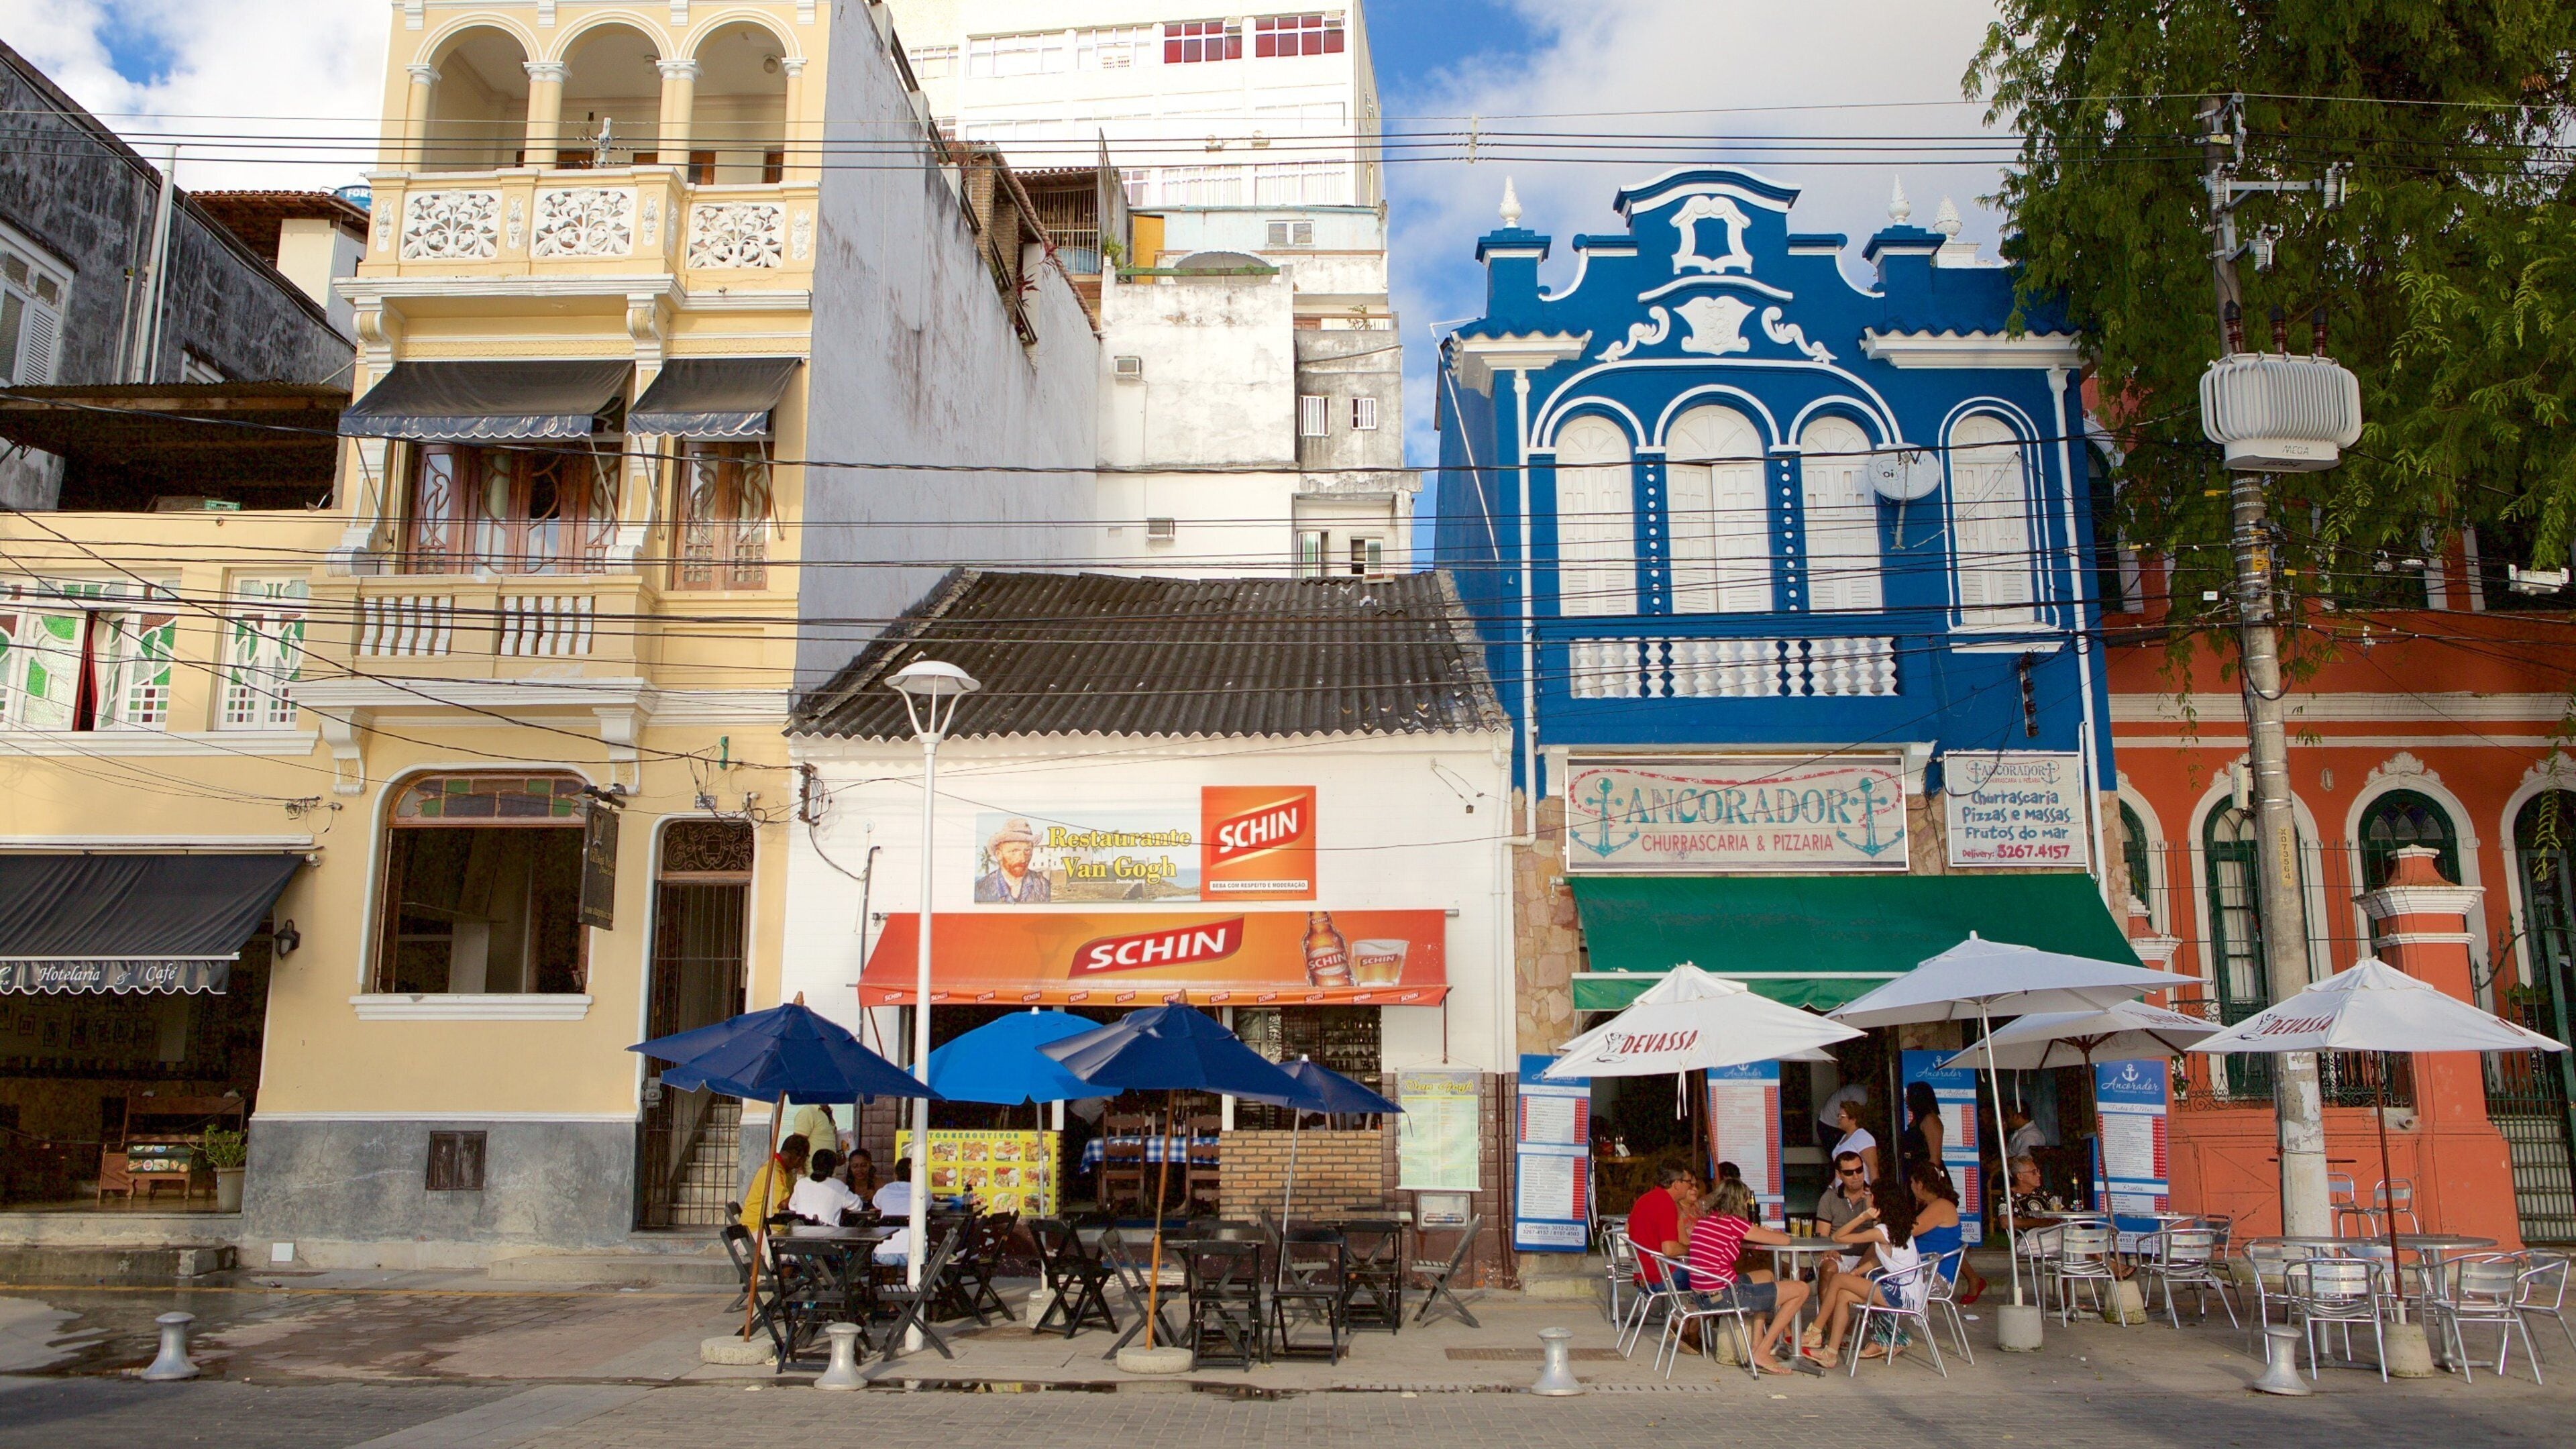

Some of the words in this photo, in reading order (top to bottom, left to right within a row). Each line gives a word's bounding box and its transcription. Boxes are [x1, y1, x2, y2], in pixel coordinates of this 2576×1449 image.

[2282, 445, 2309, 455] MEGA
[1883, 469, 1894, 478] oi
[1982, 765, 2046, 776] ANCORADOR
[1971, 790, 2059, 806] Churrascaria
[1624, 788, 1851, 824] ANCORADOR
[1962, 806, 2007, 824] Pizzas
[2011, 809, 2021, 821] e
[1048, 826, 1192, 848] Restaurante
[1219, 808, 1297, 854] SCHIN
[1965, 825, 2015, 841] Frutos
[2019, 826, 2037, 838] do
[1642, 834, 1749, 852] CHURRASCARIA
[1757, 837, 1766, 851] &
[1774, 833, 1834, 851] PIZZARIA
[1962, 849, 1994, 859] Delivery:
[1997, 844, 2071, 859] 3267.4157
[2281, 828, 2291, 880] X073564
[1062, 856, 1107, 879] Van
[1114, 855, 1177, 885] Gogh
[1087, 928, 1226, 969] SCHIN
[1308, 953, 1346, 970] SCHIN
[1362, 955, 1395, 966] SCHIN
[38, 966, 101, 983] Hotelaria
[115, 972, 131, 985] &
[146, 963, 178, 983] Café
[884, 992, 902, 1002] SCHIN
[977, 992, 994, 1002] SCHIN
[1023, 992, 1040, 1002] SCHIN
[1069, 992, 1087, 1002] SCHIN
[1116, 992, 1134, 1002] SCHIN
[1211, 993, 1228, 1002] SCHIN
[1258, 993, 1276, 1002] SCHIN
[1305, 993, 1323, 1002] SCHIN
[1353, 993, 1371, 1002] SCHIN
[1401, 992, 1419, 1002] SCHIN
[2261, 1016, 2334, 1035] DEVASSA
[1619, 1030, 1699, 1054] DEVASSA
[1438, 1079, 1473, 1094] Gogh
[2101, 1076, 2160, 1091] Ancorador
